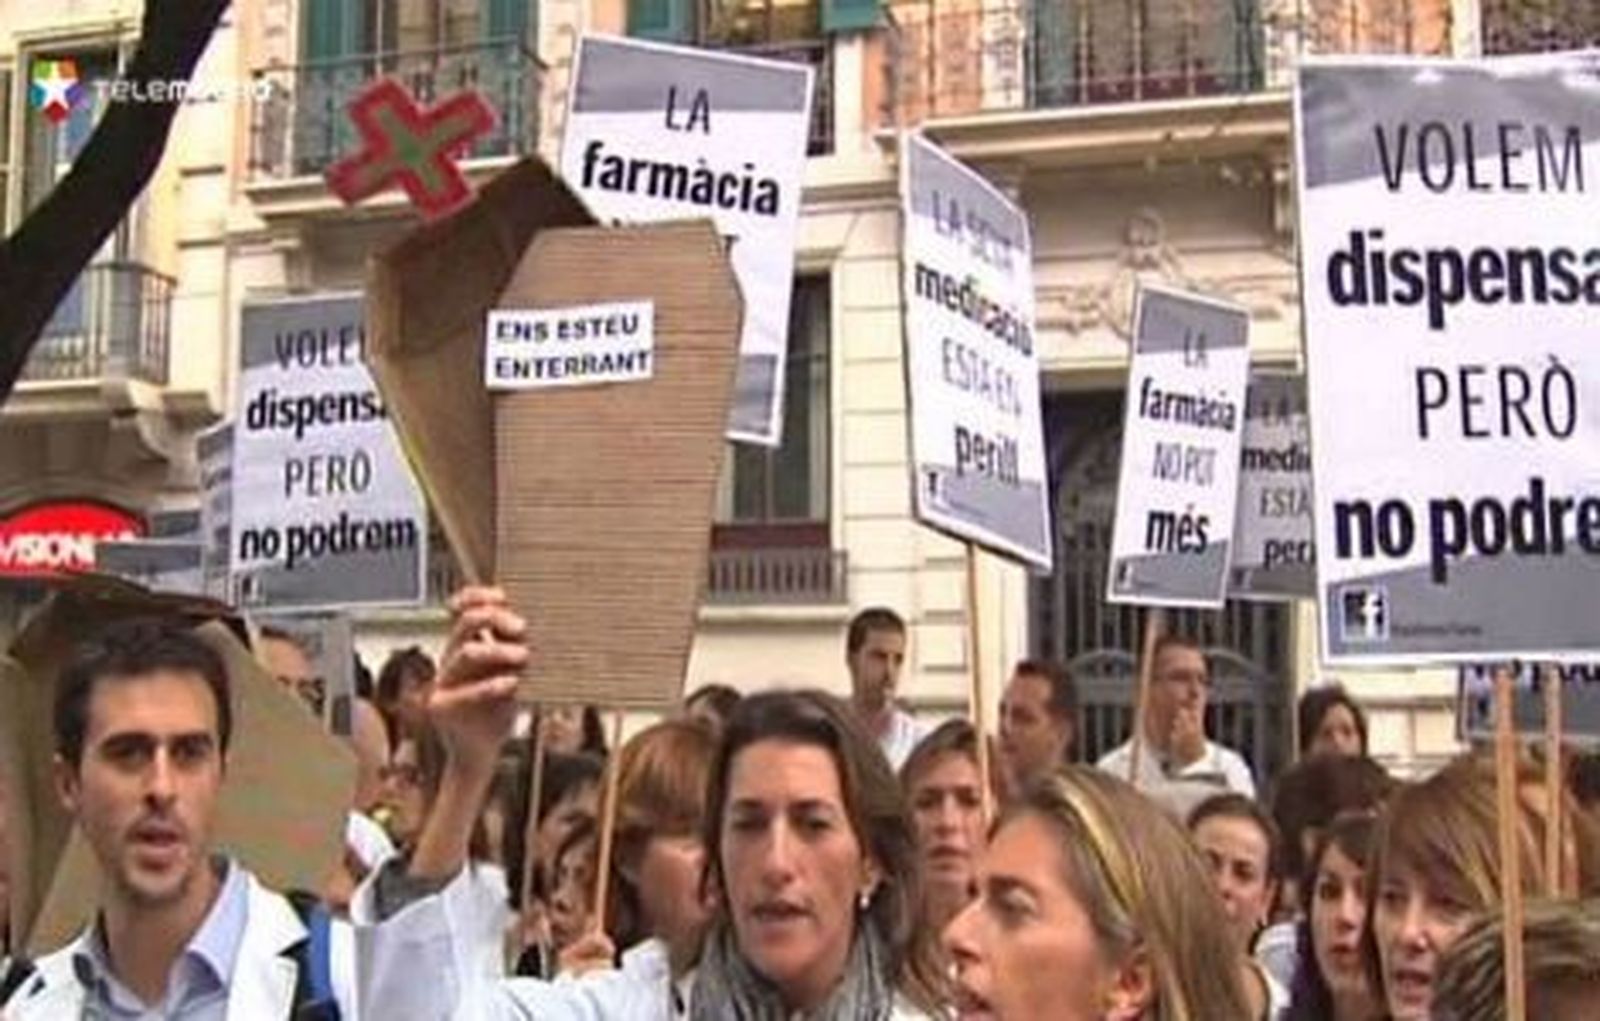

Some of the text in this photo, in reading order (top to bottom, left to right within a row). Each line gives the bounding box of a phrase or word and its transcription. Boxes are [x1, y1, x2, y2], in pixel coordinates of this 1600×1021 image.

[665, 85, 710, 134] LA
[582, 140, 779, 216] farmàcia
[1375, 120, 1584, 194] VOLEM
[274, 325, 366, 368] VOLE
[496, 312, 639, 342] ENS ESTEU
[494, 350, 650, 379] ENTERRANT
[1416, 354, 1577, 441] PERÒ
[1152, 440, 1181, 482] NO
[240, 511, 418, 570] no podrem
[1146, 504, 1210, 556] més
[1334, 497, 1415, 559] no
